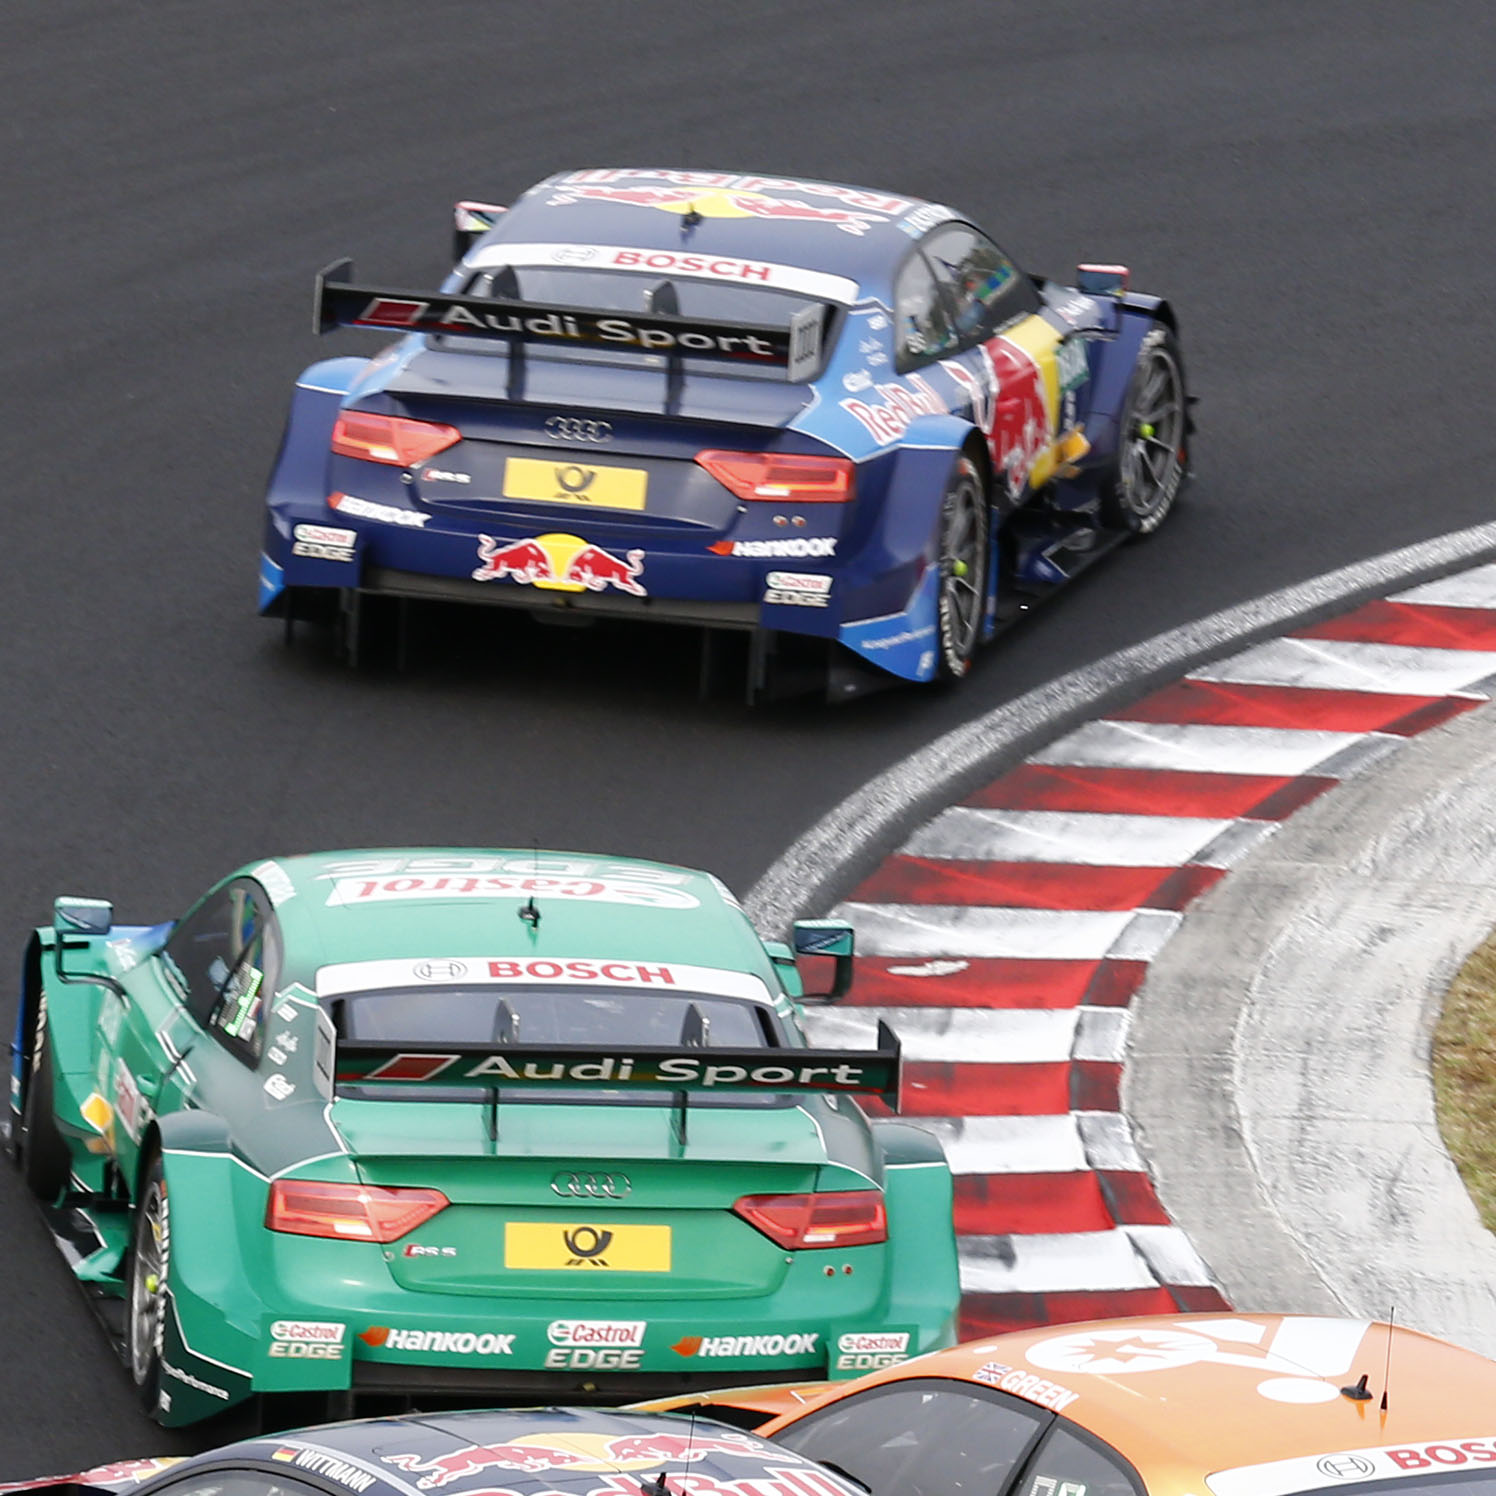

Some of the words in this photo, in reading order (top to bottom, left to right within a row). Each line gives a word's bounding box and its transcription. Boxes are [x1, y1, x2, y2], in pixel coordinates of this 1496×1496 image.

[611, 250, 774, 282] BOSCH
[443, 304, 580, 338] Audi
[595, 318, 775, 355] Sport
[356, 876, 606, 898] Castrol
[488, 960, 676, 985] BOSCH
[463, 1054, 635, 1082] Audi
[654, 1058, 863, 1087] Sport
[288, 1323, 338, 1341] Castrol
[571, 1322, 638, 1344] Castrol
[853, 1335, 906, 1352] Castrol
[268, 1341, 346, 1361] EDGE
[543, 1348, 645, 1371] EDGE
[1000, 1370, 1081, 1412] GREEN
[296, 1447, 377, 1494] WITTMANN
